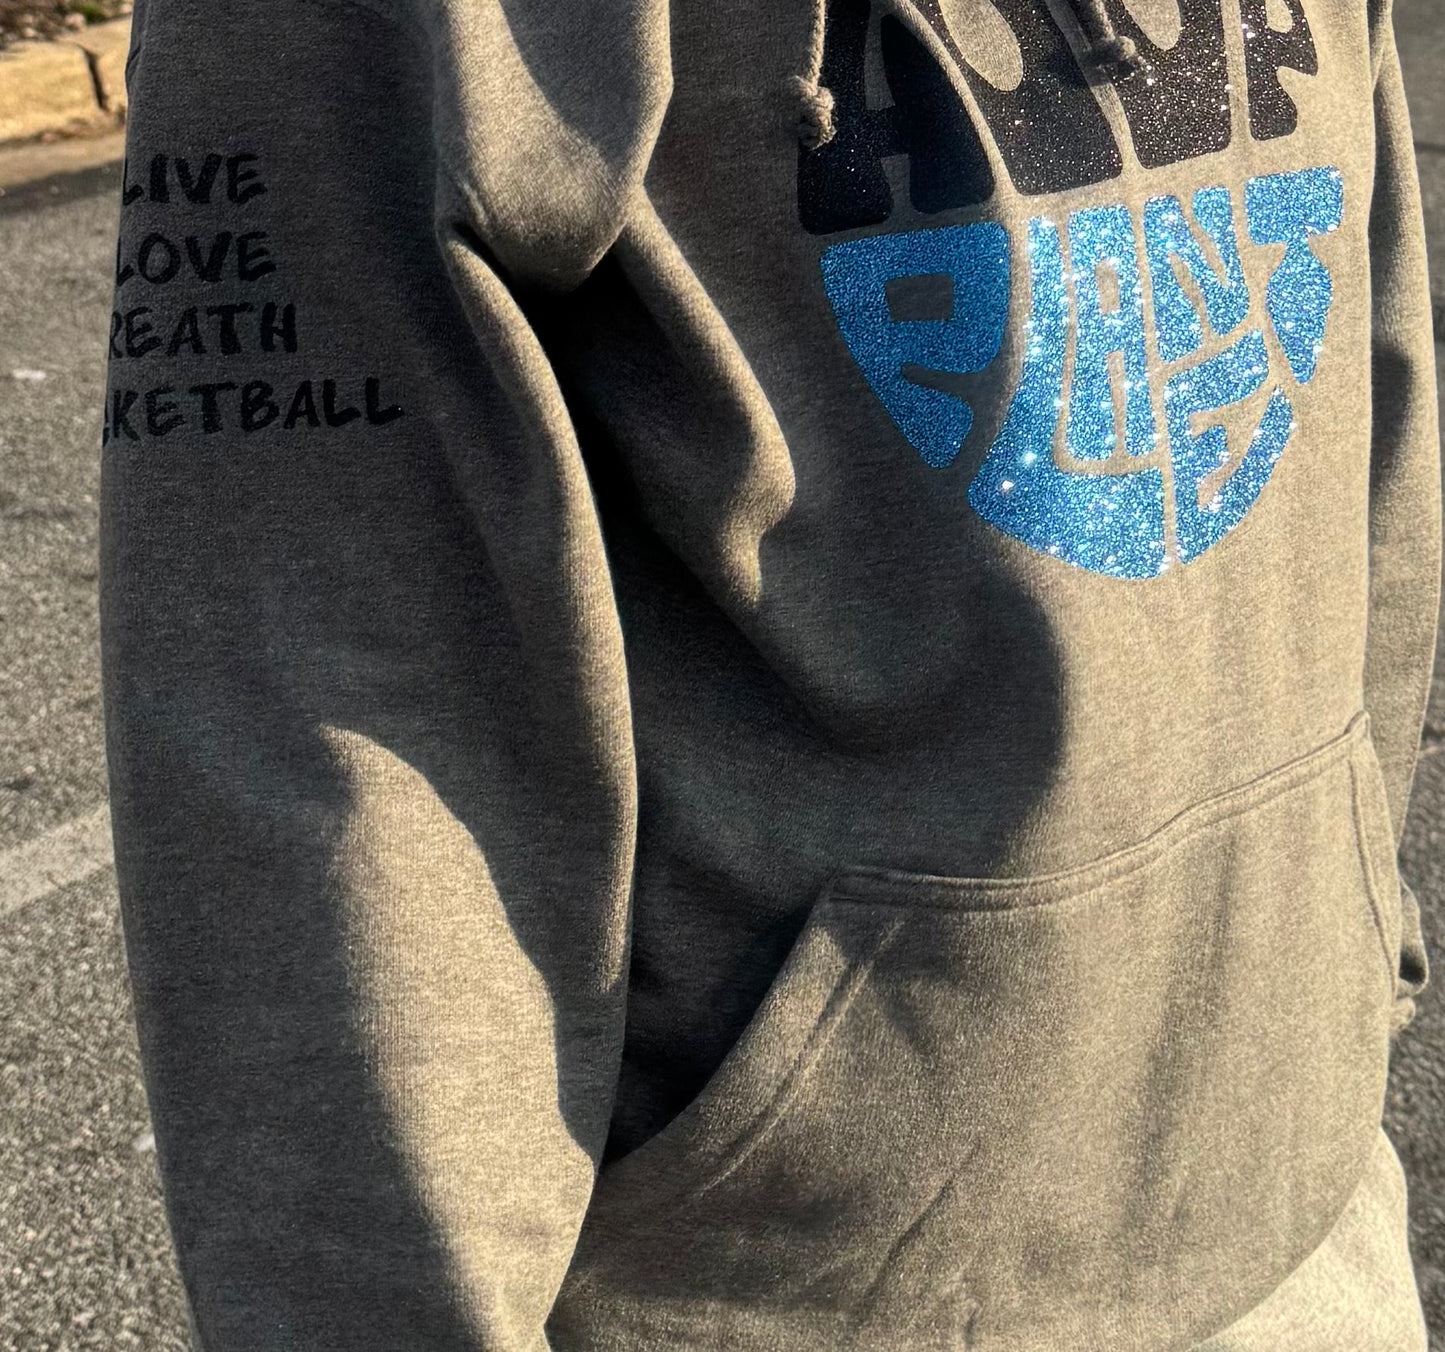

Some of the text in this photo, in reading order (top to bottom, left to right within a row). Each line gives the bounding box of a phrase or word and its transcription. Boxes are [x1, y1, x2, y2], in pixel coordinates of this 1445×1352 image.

[123, 152, 268, 206] LIVE
[116, 230, 277, 286] LOVE
[103, 377, 402, 447] KETBALL
